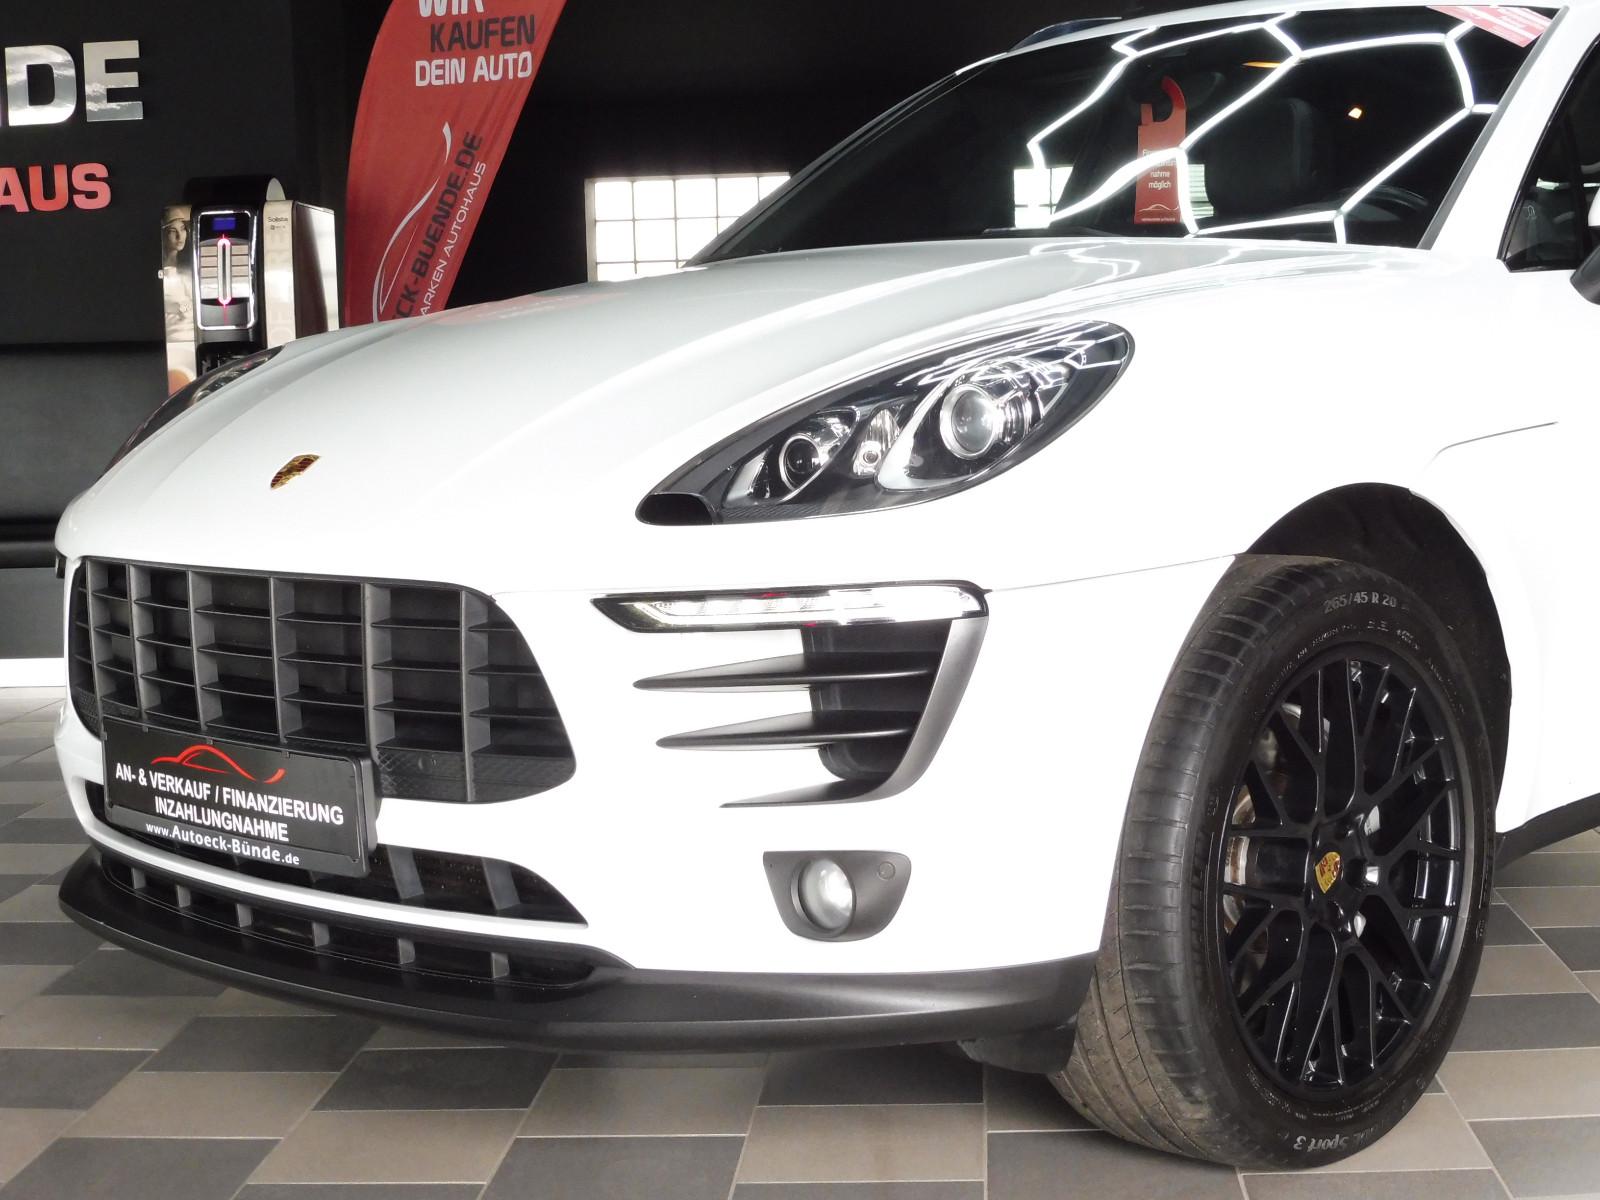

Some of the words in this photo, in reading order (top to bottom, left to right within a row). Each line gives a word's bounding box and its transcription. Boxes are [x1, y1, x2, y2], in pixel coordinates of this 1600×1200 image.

[430, 14, 535, 53] KAUFEN
[0, 40, 143, 126] DE
[415, 57, 466, 87] DEIN
[472, 51, 533, 83] AUTO
[0, 162, 111, 213] AUS
[443, 162, 487, 258] AUTOHAUS
[392, 132, 484, 319] CK-BUENDE.DE
[1371, 591, 1380, 604] R
[1382, 593, 1397, 608] 20
[115, 762, 137, 783] AN-
[138, 768, 147, 786] &
[149, 770, 211, 801] VERKAUF
[214, 785, 219, 804] /
[222, 786, 344, 825] FINANZIERUNG
[155, 795, 289, 842] INZAHLUNGNAHME
[146, 823, 300, 865] www.Autoeck-Bünde.de
[1293, 1135, 1307, 1150] 3
